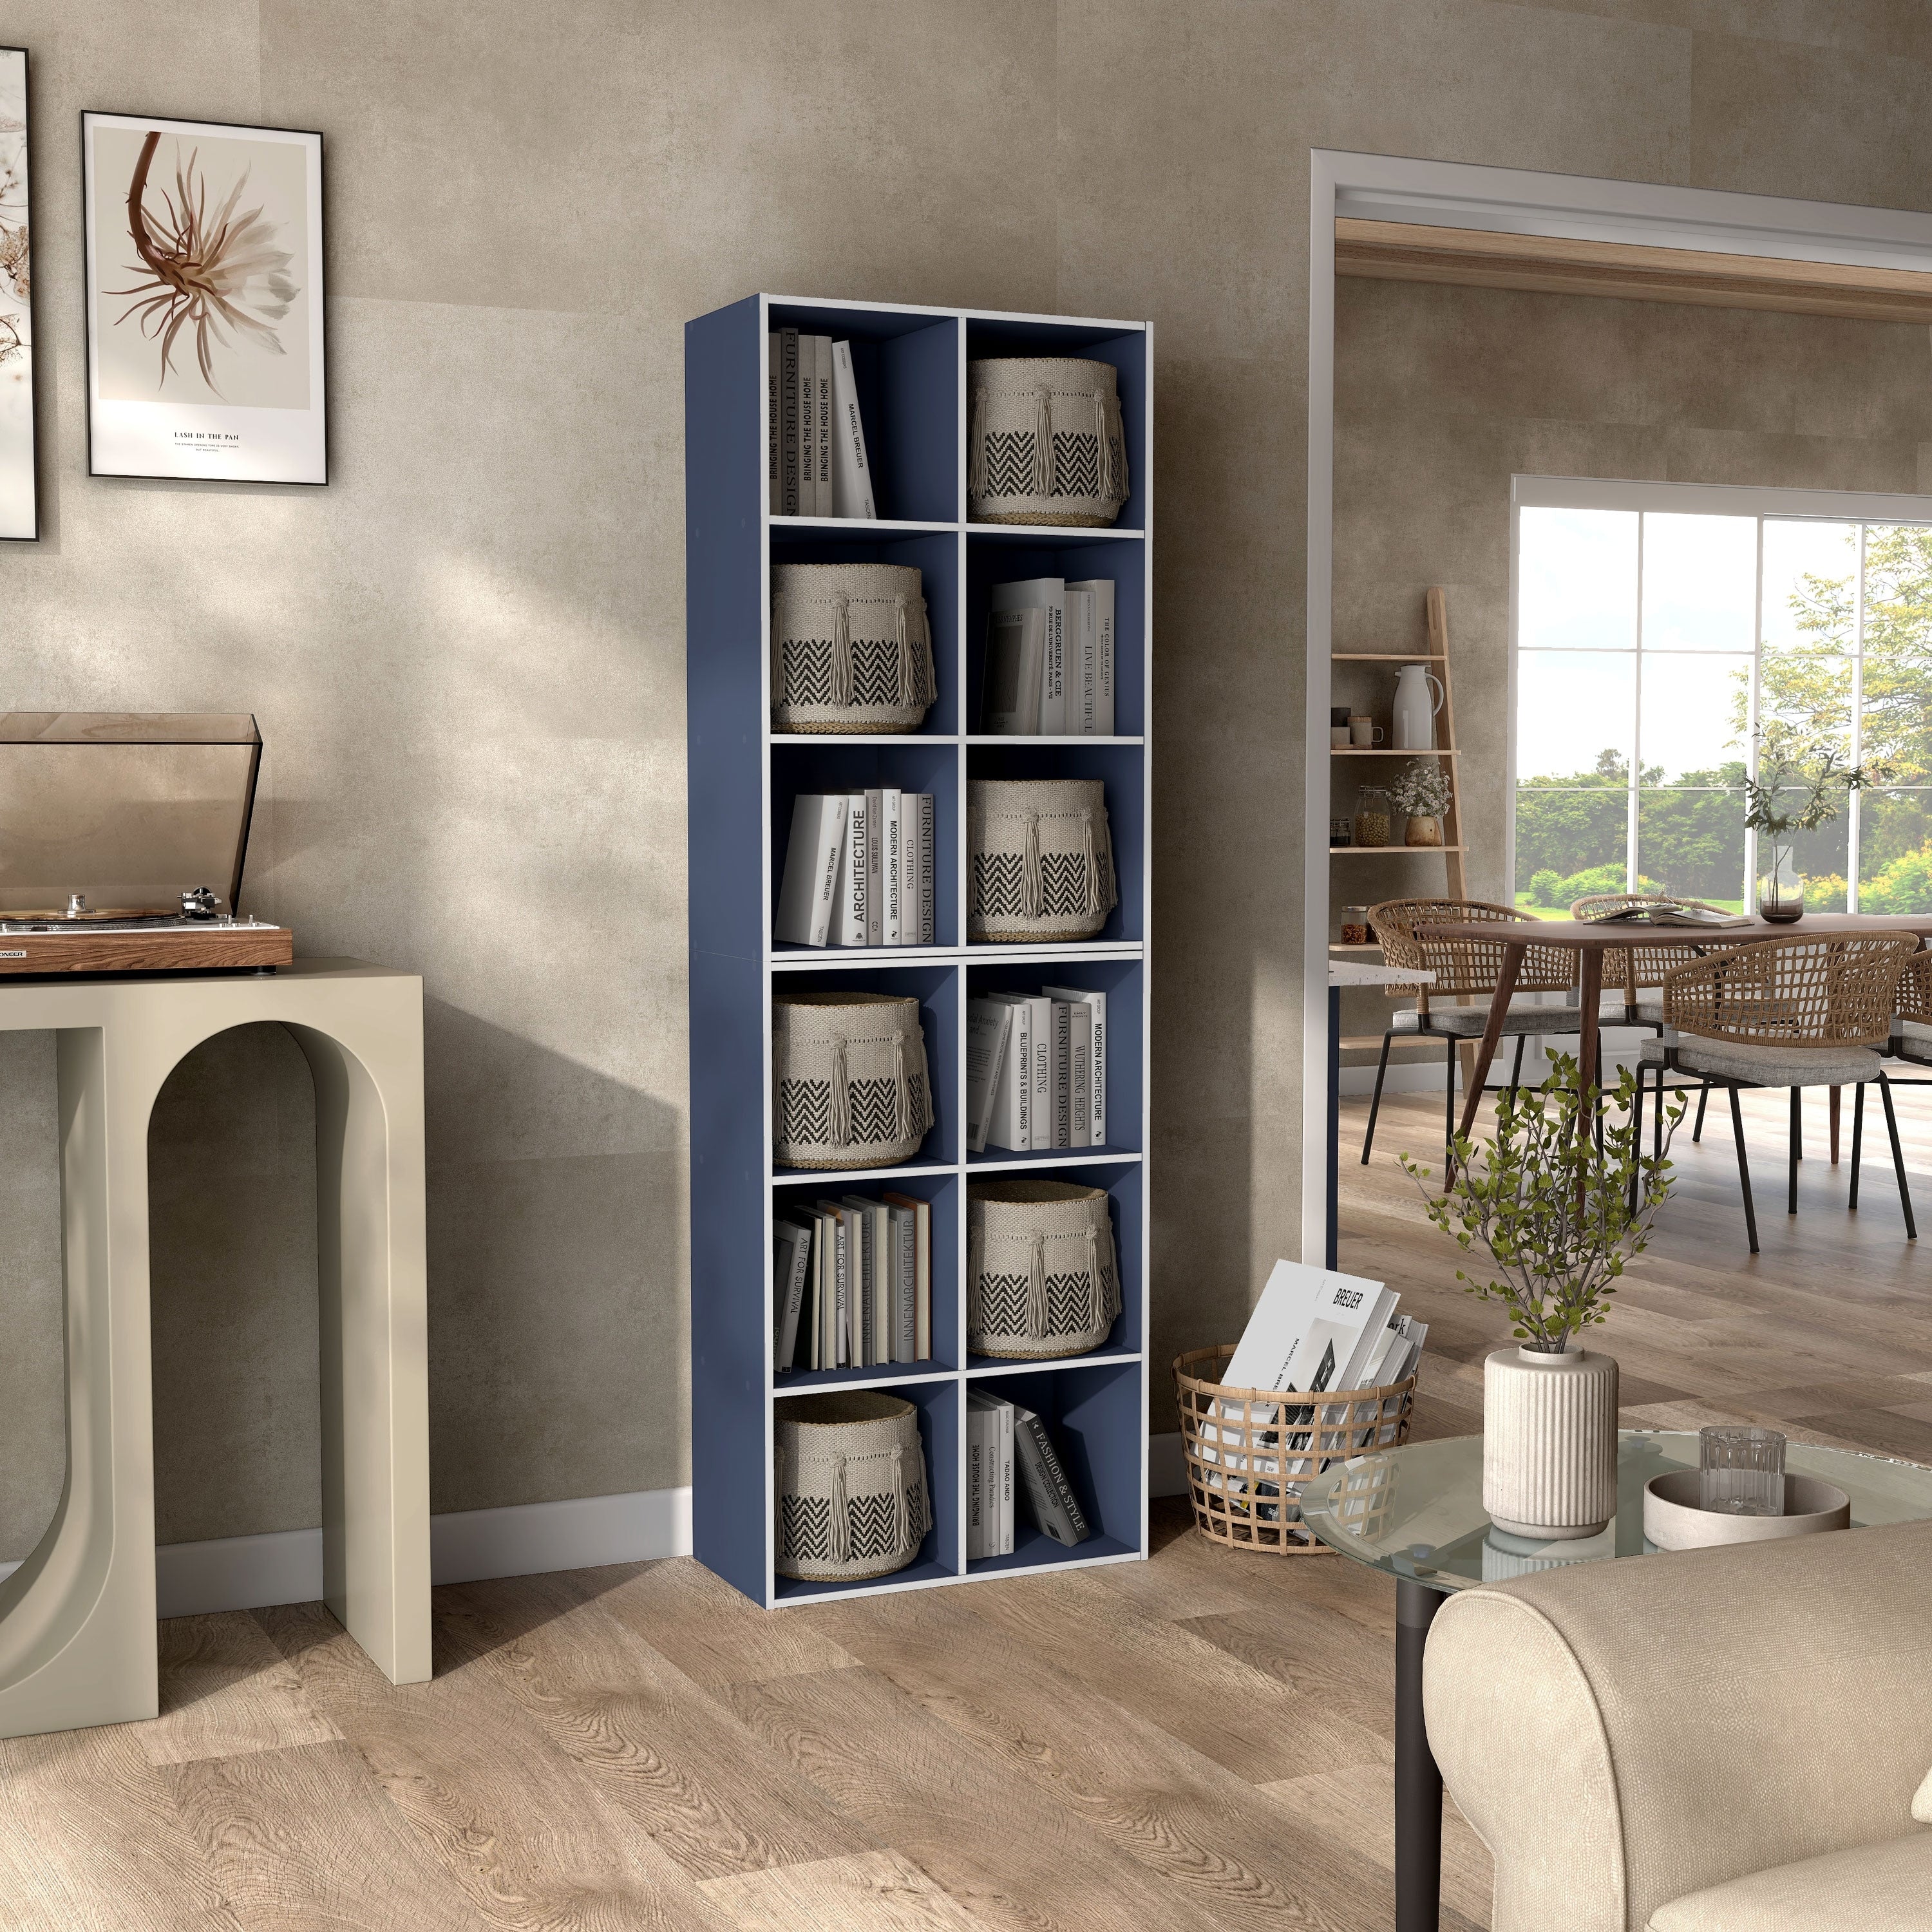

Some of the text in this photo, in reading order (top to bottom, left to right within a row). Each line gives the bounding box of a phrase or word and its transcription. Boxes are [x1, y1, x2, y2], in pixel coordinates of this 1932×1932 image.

[820, 378, 828, 399] HOME
[769, 426, 777, 440] THE
[786, 332, 796, 516] FURNITURE DESIGN
[803, 401, 811, 426] HOUSE
[803, 428, 811, 442] THE
[848, 403, 864, 469] MARCEL BREUER
[769, 443, 777, 480] BRINGING
[803, 444, 811, 481] BRINGING
[1104, 659, 1109, 668] OF
[1084, 646, 1093, 732] LIVE BEAUTIFUL
[823, 848, 836, 901] MARCEL BREUER
[853, 810, 864, 922] ARCHITECTURE
[922, 797, 931, 943] FURNITURE DESIGN
[969, 1025, 980, 1035] and
[978, 1014, 999, 1030] Anxiety
[1094, 1023, 1103, 1057] MODERN
[1037, 1043, 1047, 1094] CLOTHING
[1058, 1007, 1067, 1147] FURNITURE DESIGN
[1075, 1045, 1085, 1132] WUTHERING HEIGHTS
[790, 1237, 808, 1314] ART FOR SURVIVAL
[862, 1222, 871, 1344] INNENARCHITEKTUR
[903, 1220, 914, 1341] INNENARCHITEKTUR
[1332, 1287, 1363, 1310] BREUER
[1281, 1338, 1300, 1372] MARCEL
[987, 1446, 996, 1483] Constructing
[1035, 1462, 1047, 1481] DESIGN
[1043, 1479, 1059, 1508] COLLECTION
[1036, 1432, 1084, 1531] FASHION & STYLE
